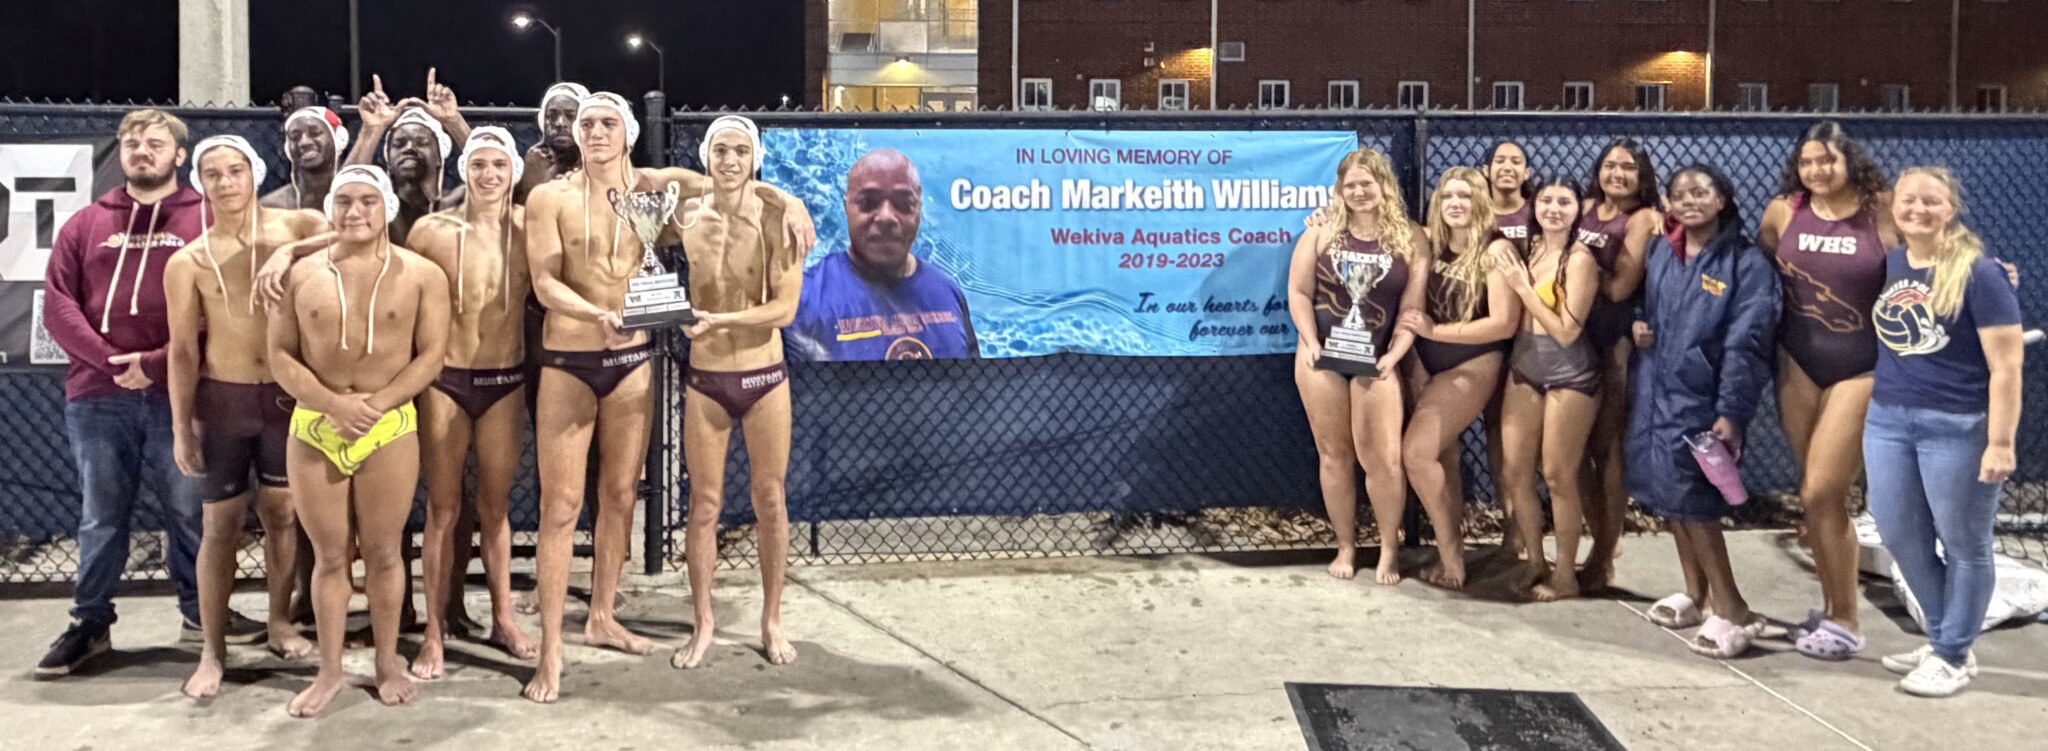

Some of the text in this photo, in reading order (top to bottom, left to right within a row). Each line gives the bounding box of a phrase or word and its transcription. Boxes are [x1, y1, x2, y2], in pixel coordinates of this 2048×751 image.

[1016, 148, 1232, 165] IN LOVING MEMORY OF
[950, 178, 1050, 211] Coach
[1061, 178, 1206, 211] Markeith
[1050, 228, 1292, 248] Wekiva Aquatics Coach
[1798, 233, 1857, 255] WHS
[1118, 252, 1225, 269] 2019-2023
[1134, 292, 1160, 314] In
[1166, 302, 1198, 313] our
[1203, 296, 1259, 314] hearts
[1189, 320, 1290, 342] forever our
